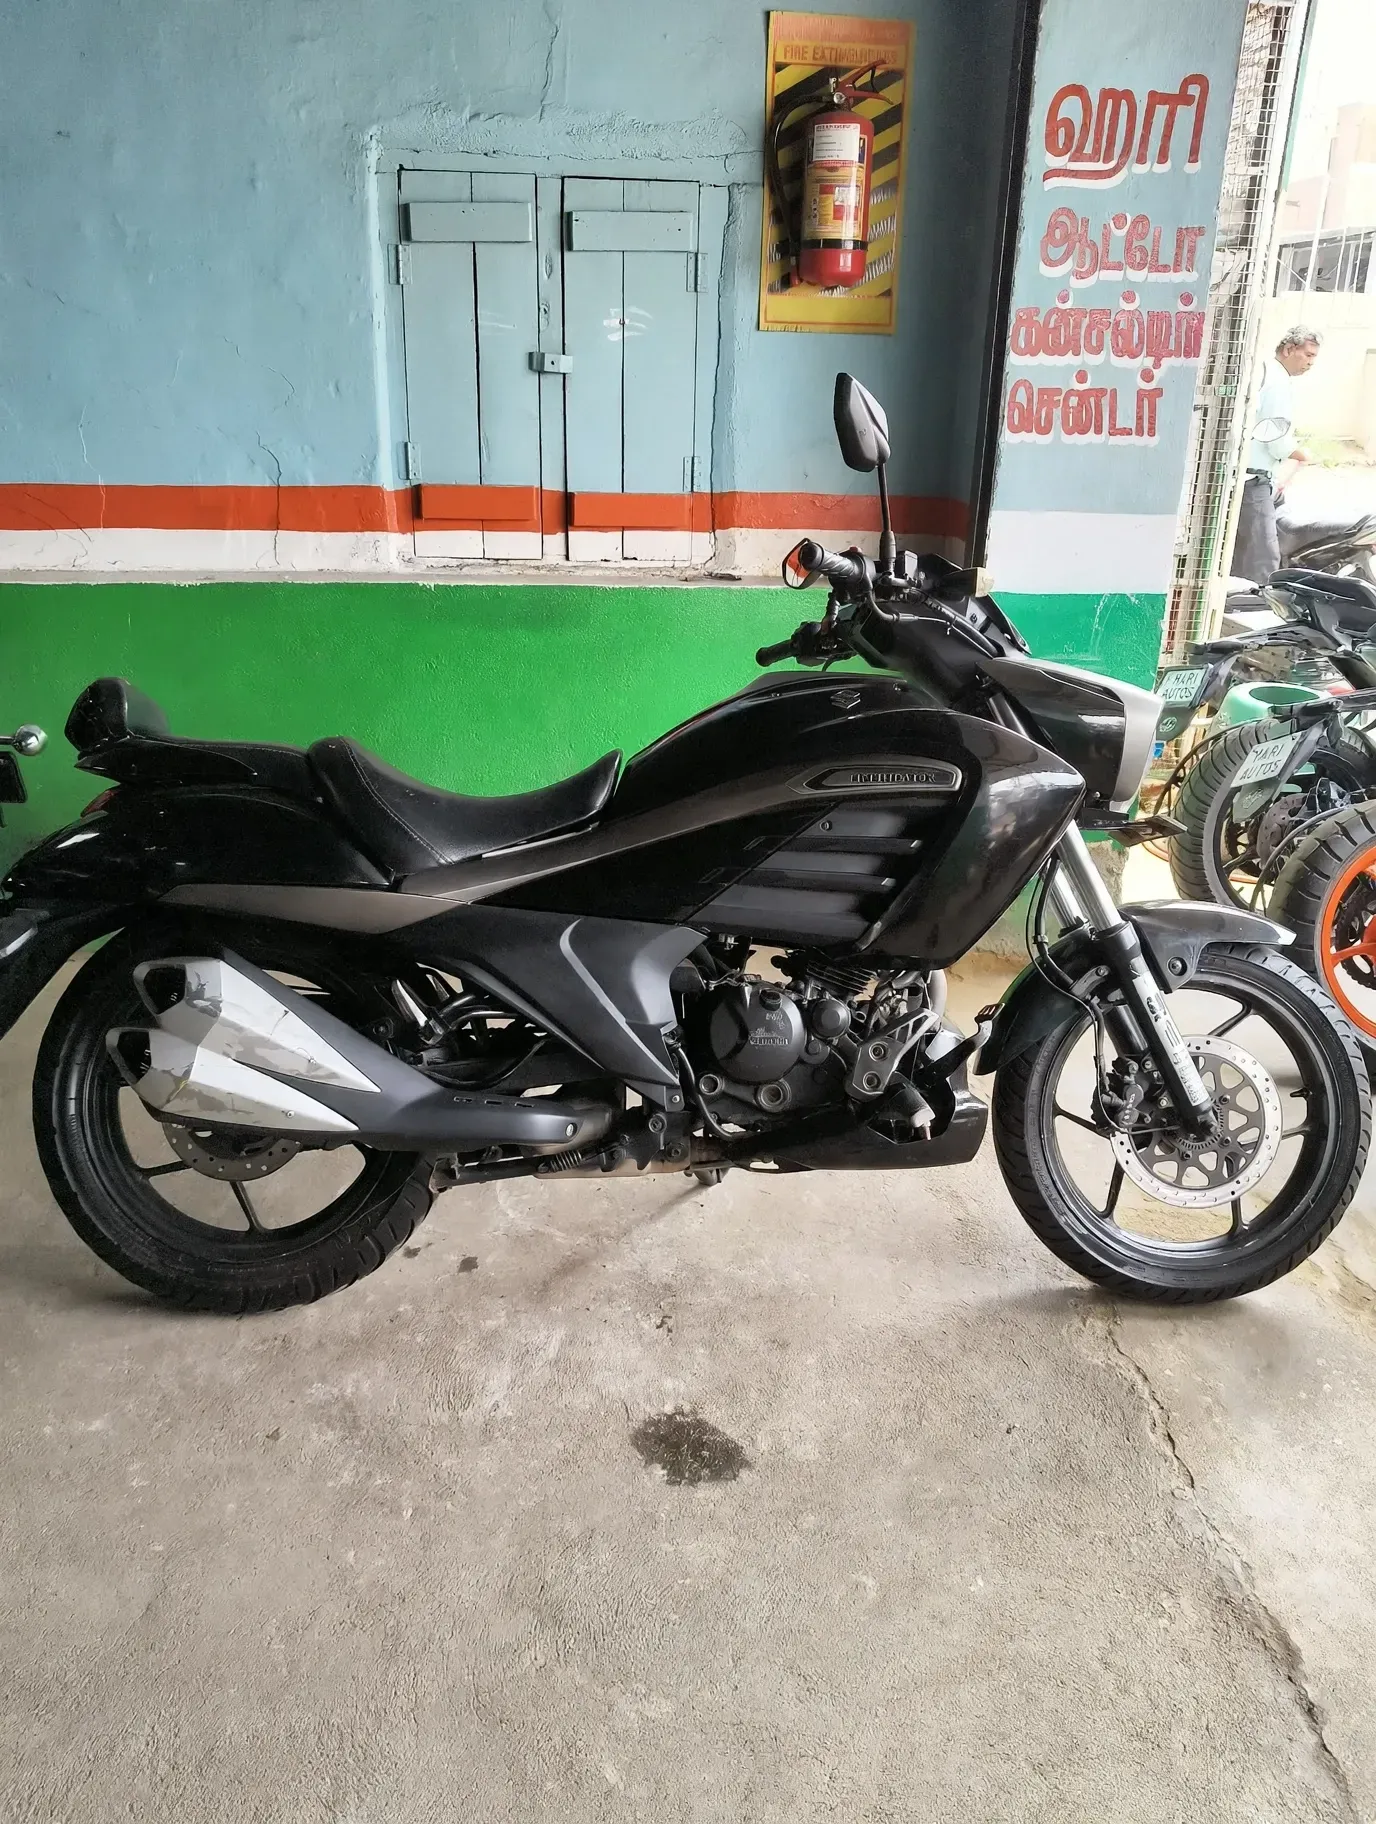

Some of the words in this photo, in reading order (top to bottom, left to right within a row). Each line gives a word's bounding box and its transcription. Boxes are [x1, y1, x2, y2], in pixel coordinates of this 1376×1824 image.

[783, 45, 808, 61] FIRE
[1043, 73, 1210, 186] ஹரி
[1039, 206, 1206, 283] ஆட்டோ
[1005, 368, 1164, 441] சென்டர்
[1162, 687, 1195, 699] AUTOS
[1240, 759, 1281, 780] AUTOS
